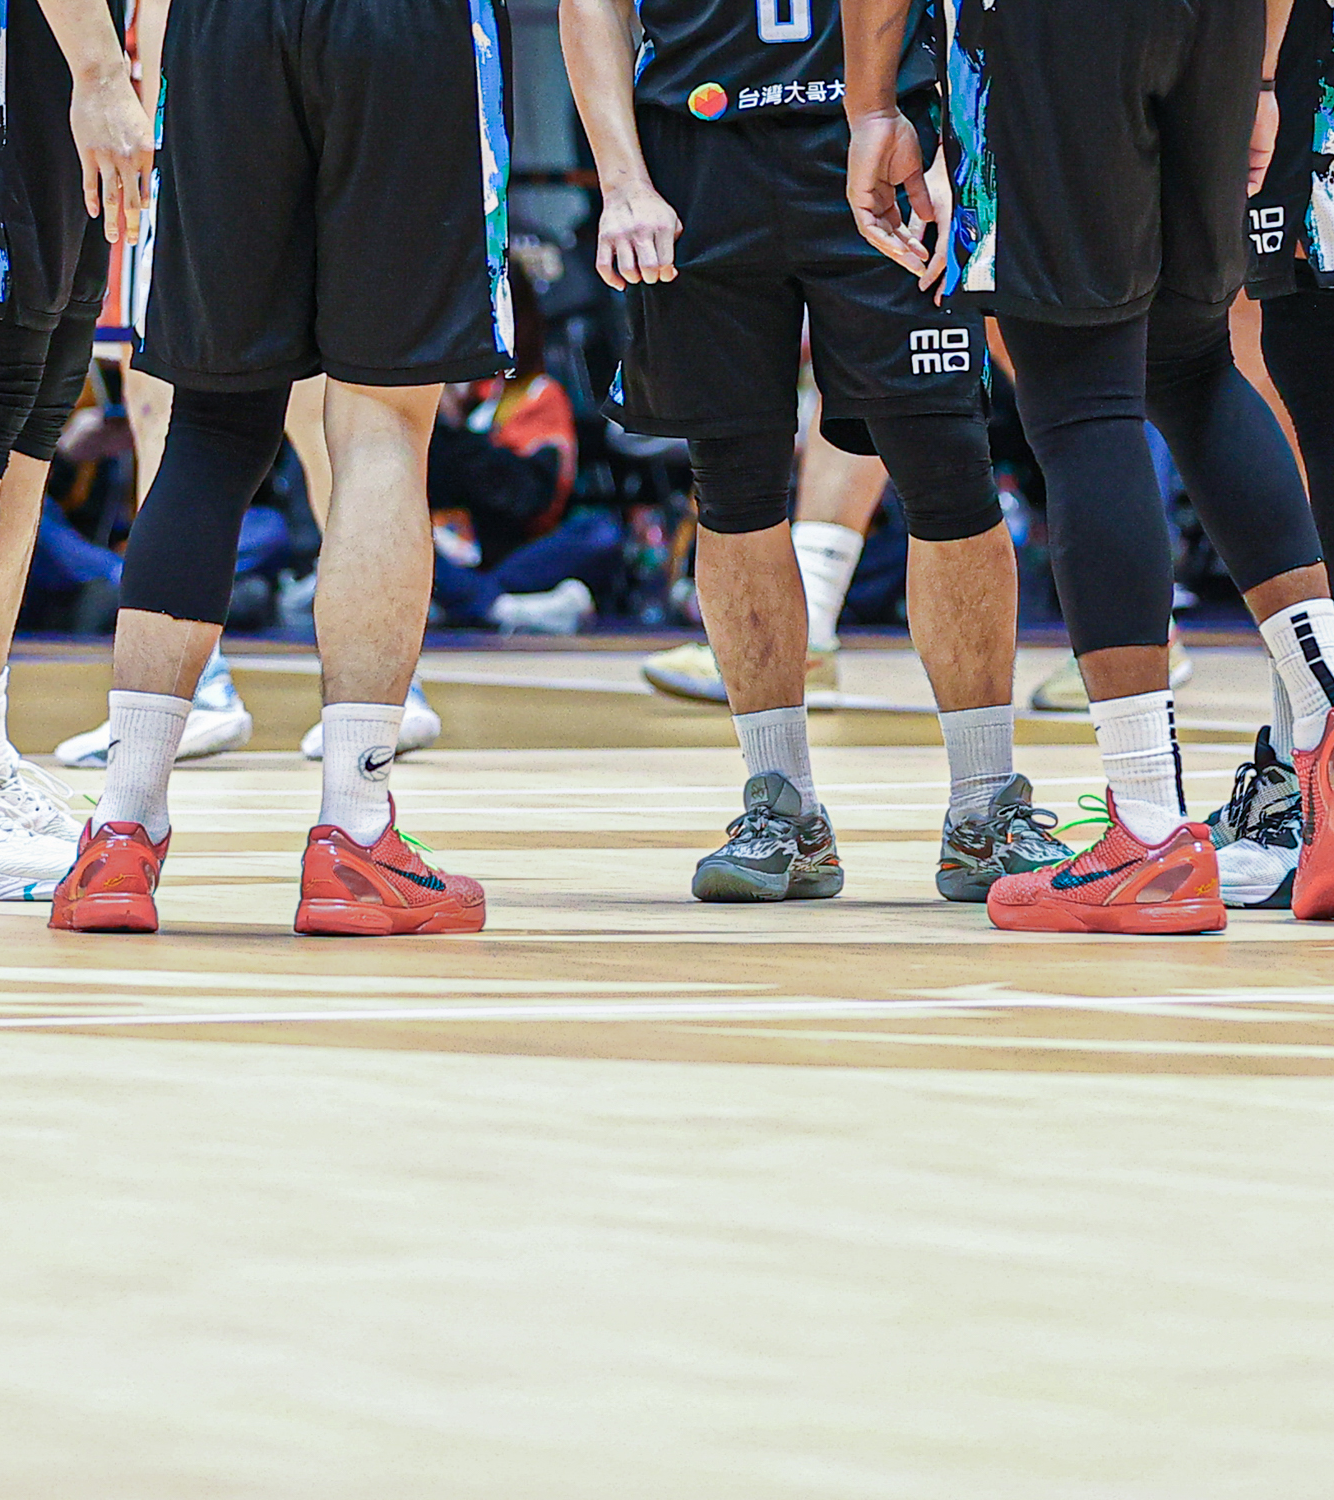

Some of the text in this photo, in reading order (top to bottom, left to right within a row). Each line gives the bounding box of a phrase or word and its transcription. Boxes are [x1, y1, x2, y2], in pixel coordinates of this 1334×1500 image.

[737, 78, 846, 110] 台灣大哥大
